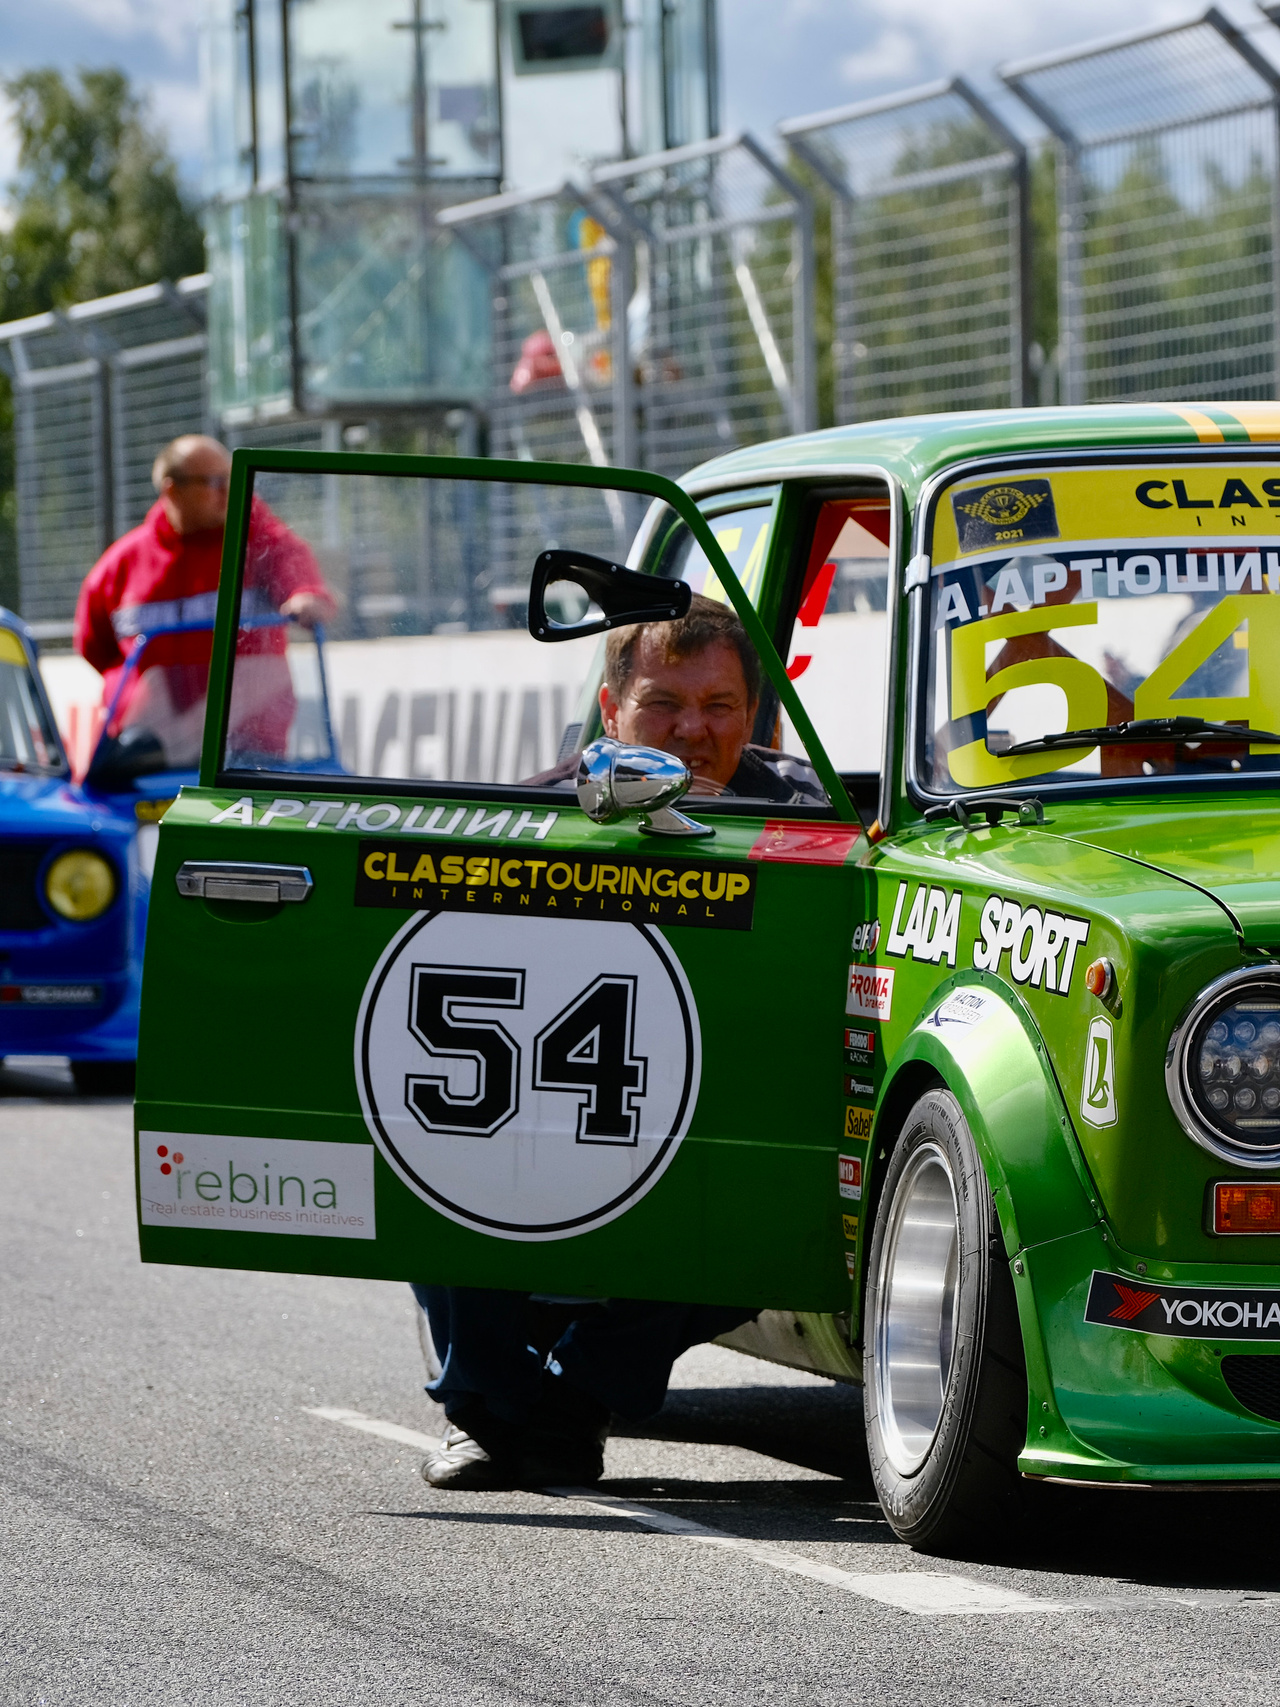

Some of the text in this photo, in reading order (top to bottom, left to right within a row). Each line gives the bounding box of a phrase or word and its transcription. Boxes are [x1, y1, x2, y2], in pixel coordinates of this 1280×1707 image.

[995, 529, 1024, 541] 2021
[208, 798, 560, 841] АРТЮШИН
[391, 886, 716, 918] INTERNATIONAL
[852, 922, 871, 951] elf
[885, 879, 1091, 997] LADA SPORT
[864, 997, 885, 1010] brakes
[405, 963, 648, 1147] 54
[175, 1160, 337, 1210] rebina
[151, 1201, 365, 1227] real estate business initiatives
